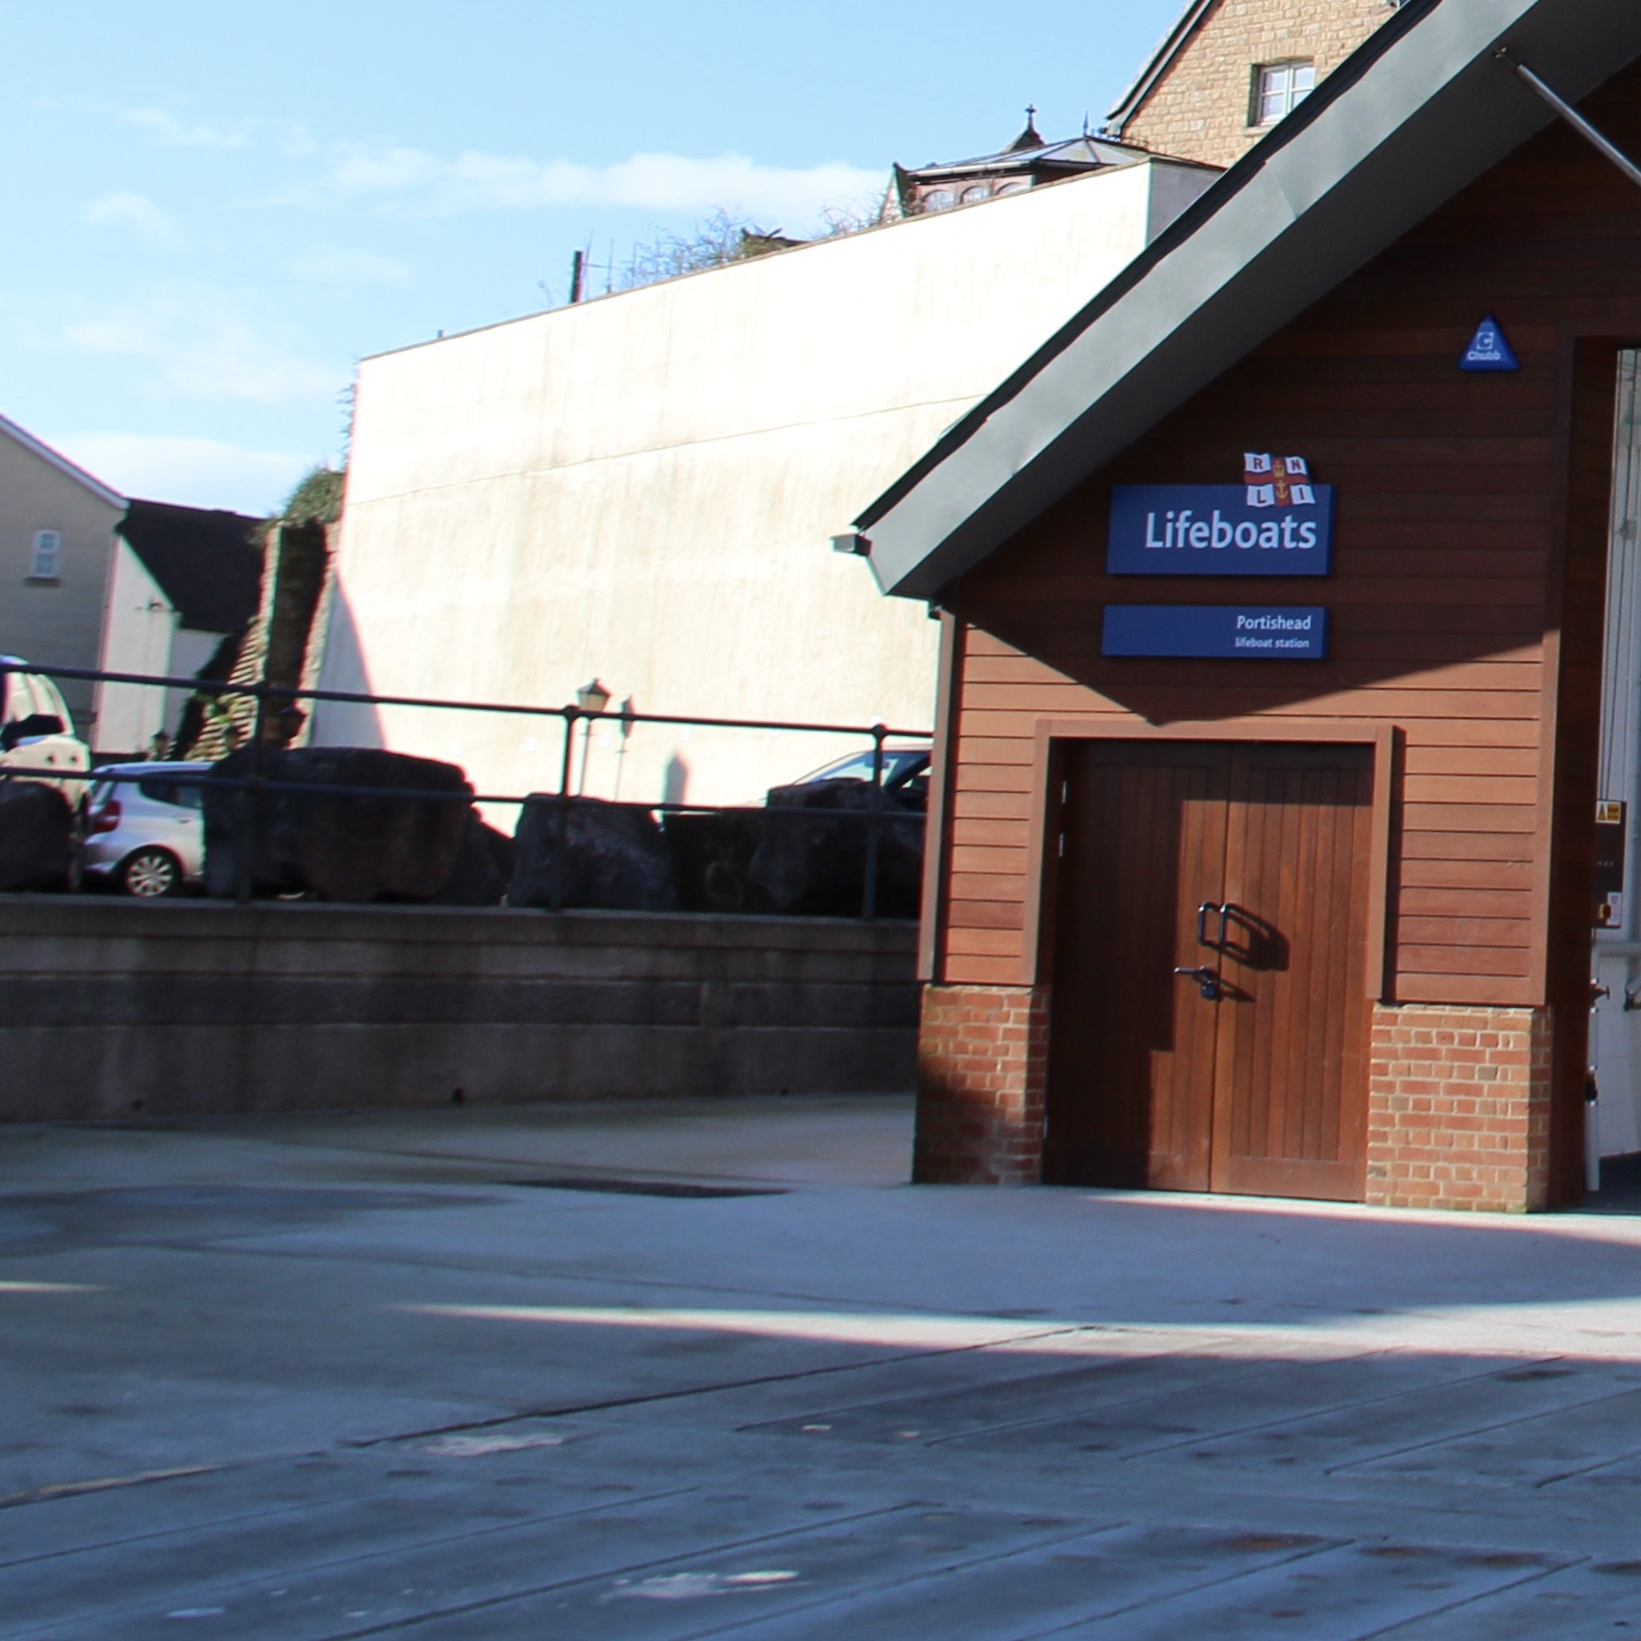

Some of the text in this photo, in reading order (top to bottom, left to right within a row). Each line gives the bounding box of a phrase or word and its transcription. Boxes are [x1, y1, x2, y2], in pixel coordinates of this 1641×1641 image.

[1467, 350, 1501, 361] Chubb
[1144, 510, 1317, 549] Lifeboats
[1236, 614, 1312, 630] Portishead
[1235, 636, 1310, 648] lifeboat station
